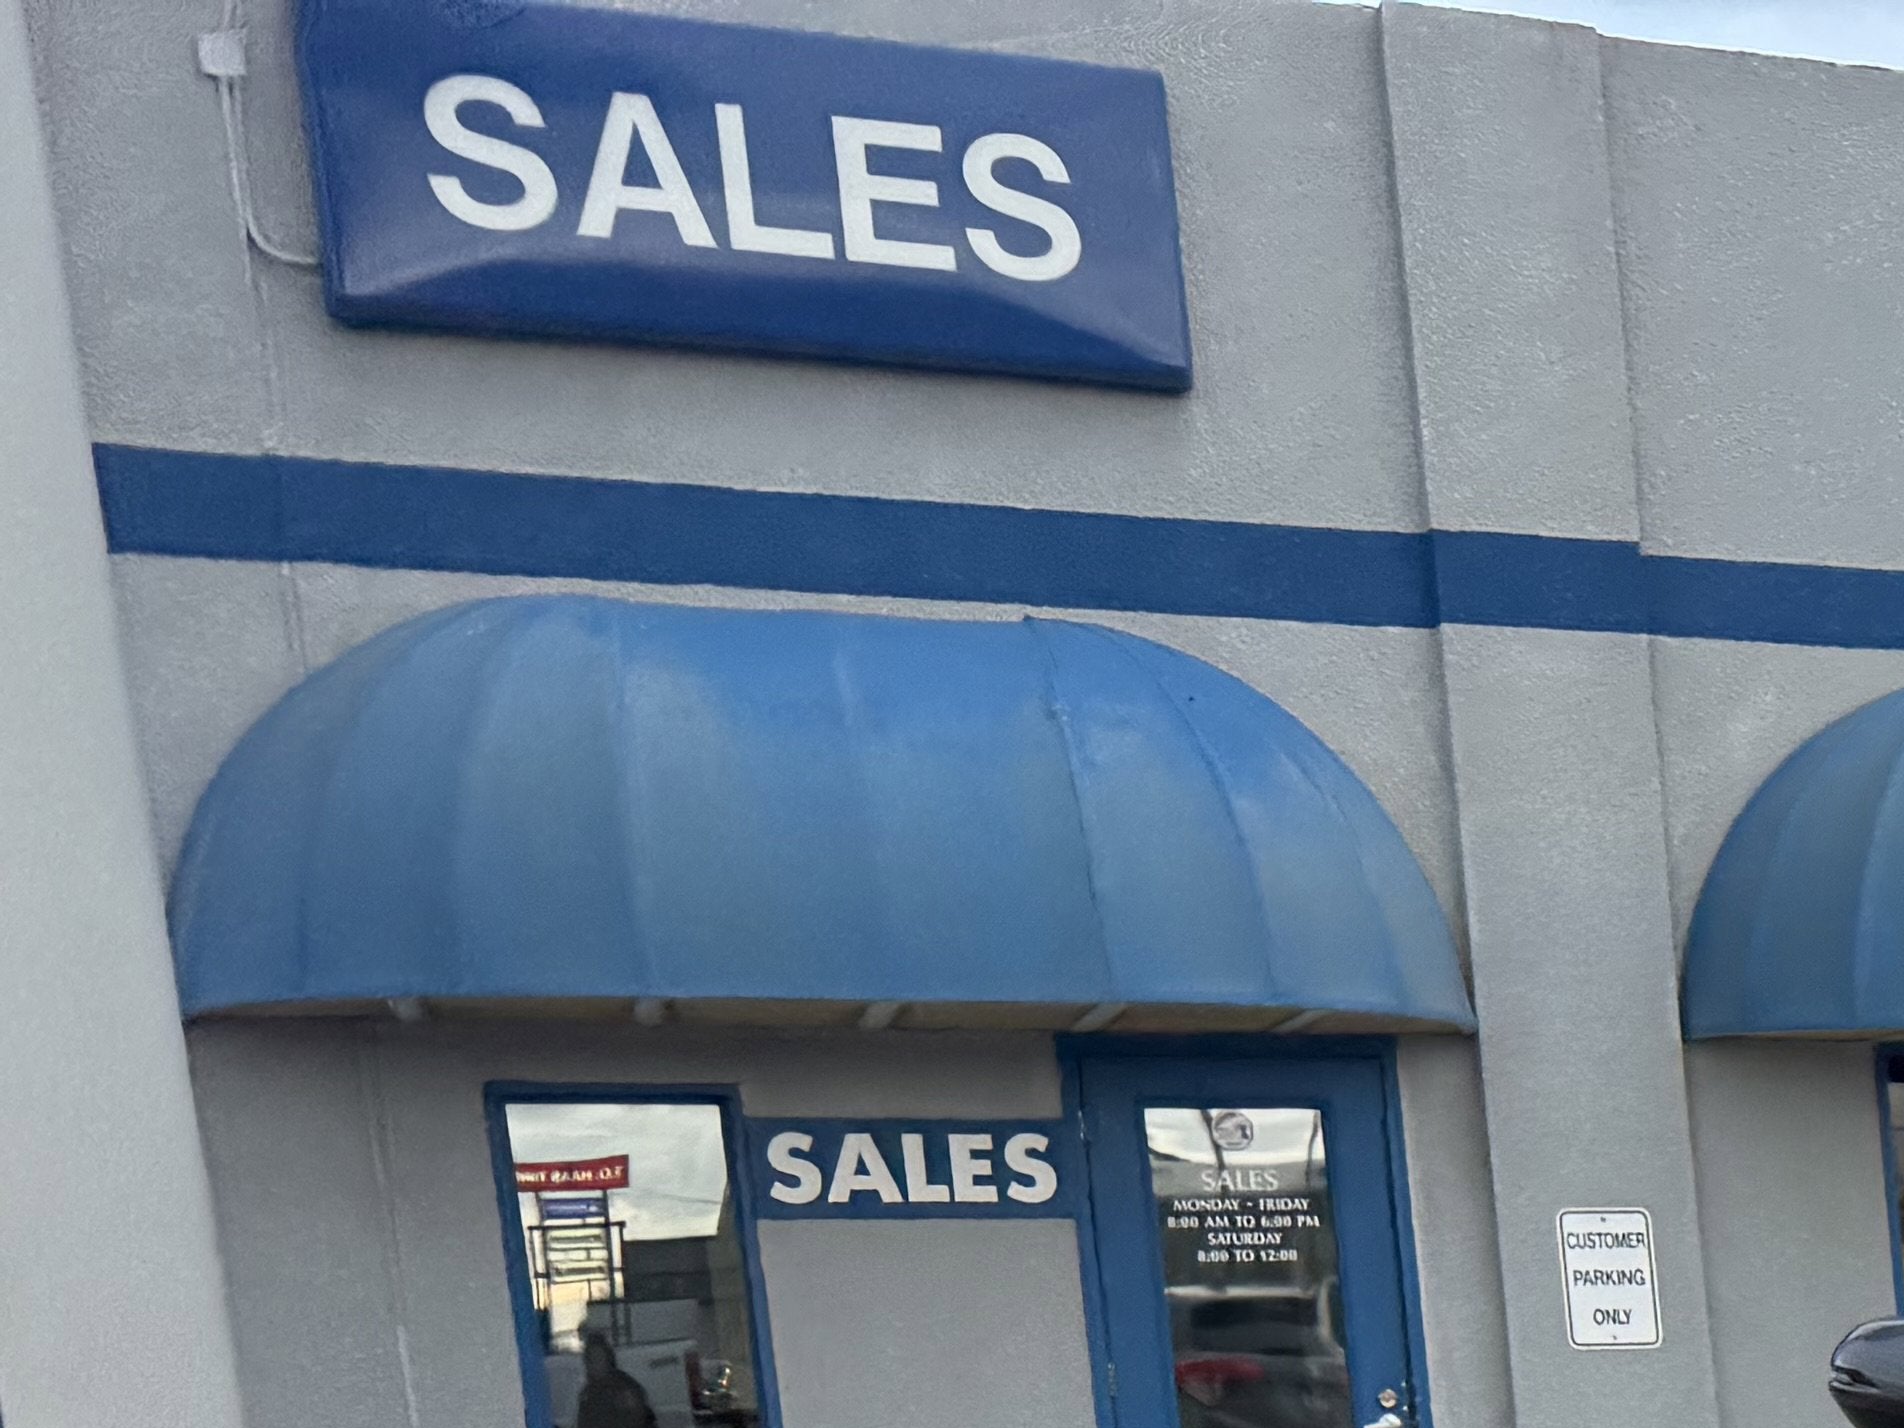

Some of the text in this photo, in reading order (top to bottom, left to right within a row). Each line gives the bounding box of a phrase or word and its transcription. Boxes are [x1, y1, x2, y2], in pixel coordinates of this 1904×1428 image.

[423, 73, 1083, 282] SALES
[766, 1131, 1058, 1204] SALES
[1200, 1169, 1279, 1191] SALES
[1173, 1198, 1240, 1211] MONDAY
[1258, 1198, 1311, 1211] FRIDAY
[1204, 1216, 1230, 1228] AM
[1235, 1215, 1256, 1228] TO
[1296, 1215, 1321, 1227] PM
[1207, 1232, 1283, 1245] SATURDAY
[1566, 1231, 1647, 1250] CUSTOMER
[1235, 1249, 1255, 1262] TO
[1260, 1249, 1298, 1262] 12:00
[1573, 1268, 1646, 1287] PARKING
[1592, 1308, 1632, 1325] ONLY
